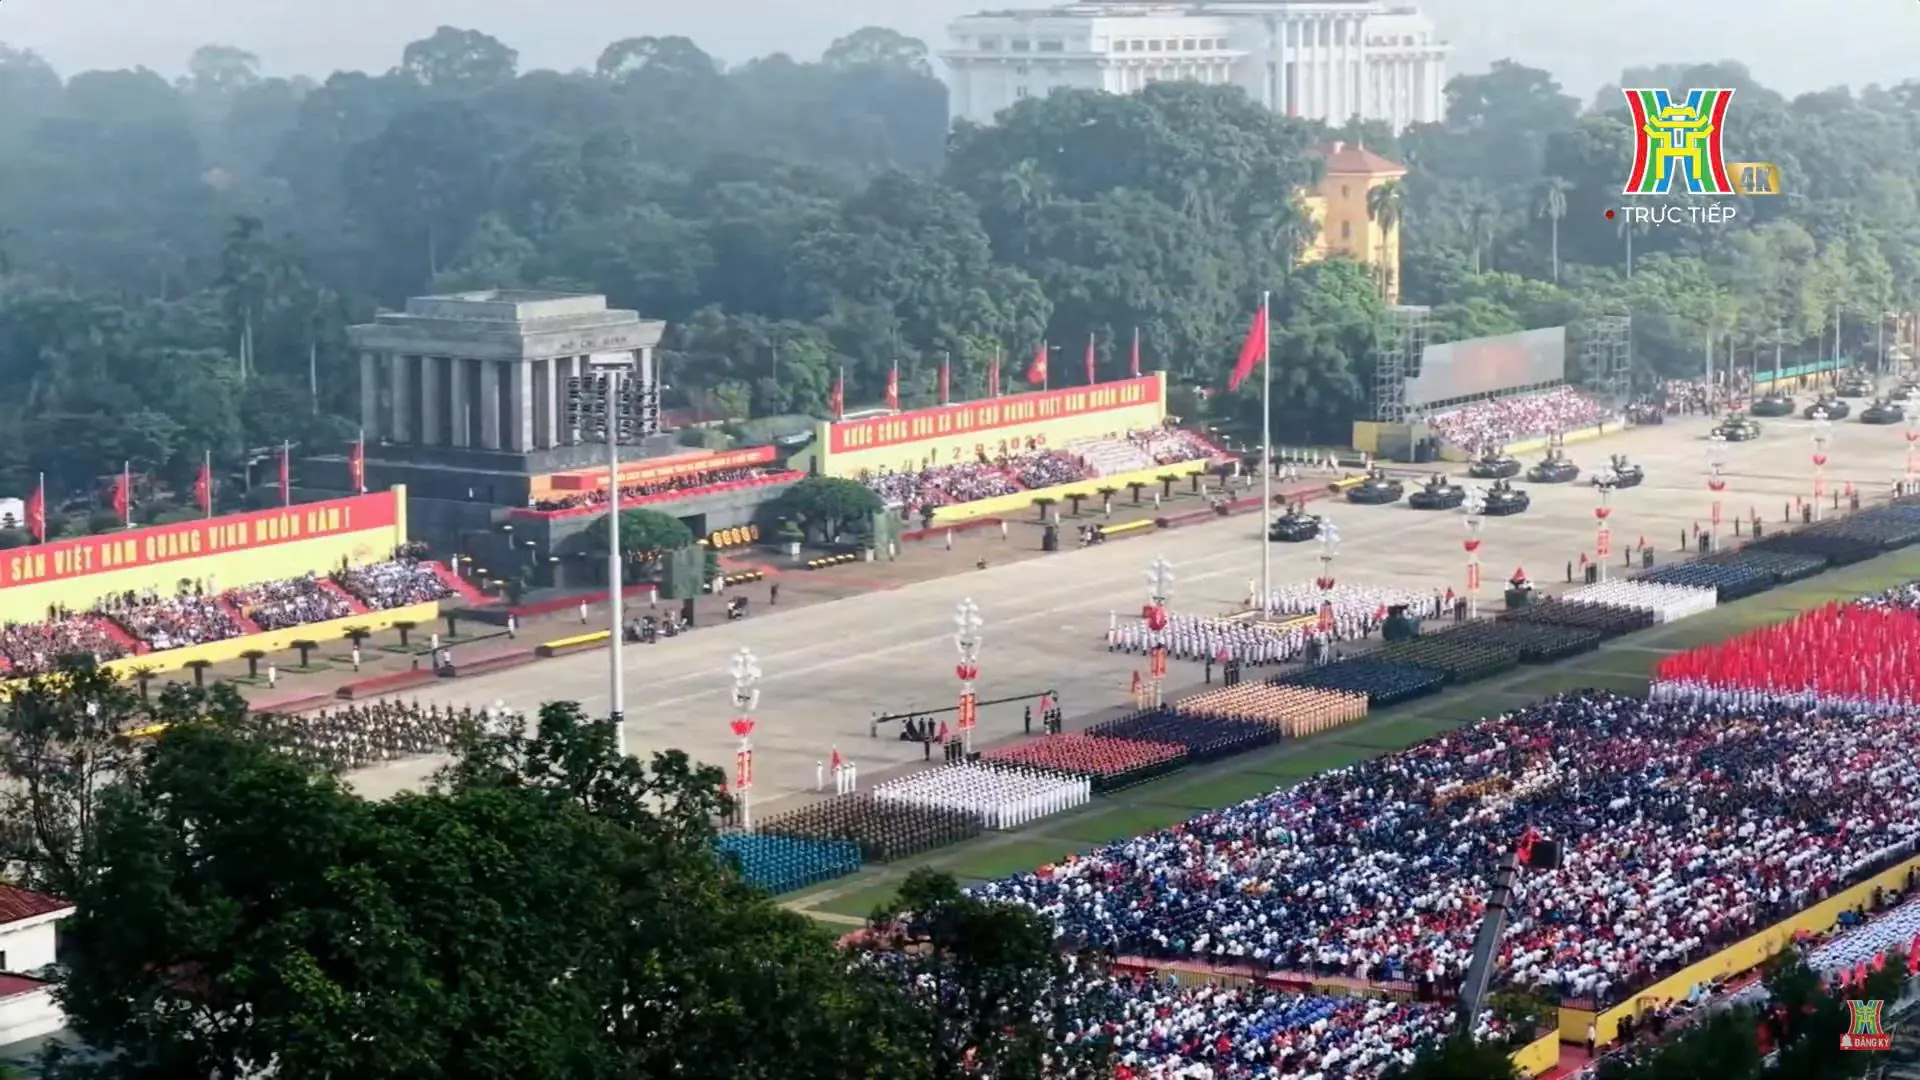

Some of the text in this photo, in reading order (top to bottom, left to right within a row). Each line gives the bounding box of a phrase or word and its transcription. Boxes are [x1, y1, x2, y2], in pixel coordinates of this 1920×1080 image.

[54, 543, 93, 576] VIỆT
[101, 540, 138, 568] NAM
[146, 529, 201, 561] QUANG
[208, 522, 248, 549] VINH
[256, 512, 300, 542] MUÔN
[307, 506, 340, 534] NĂM
